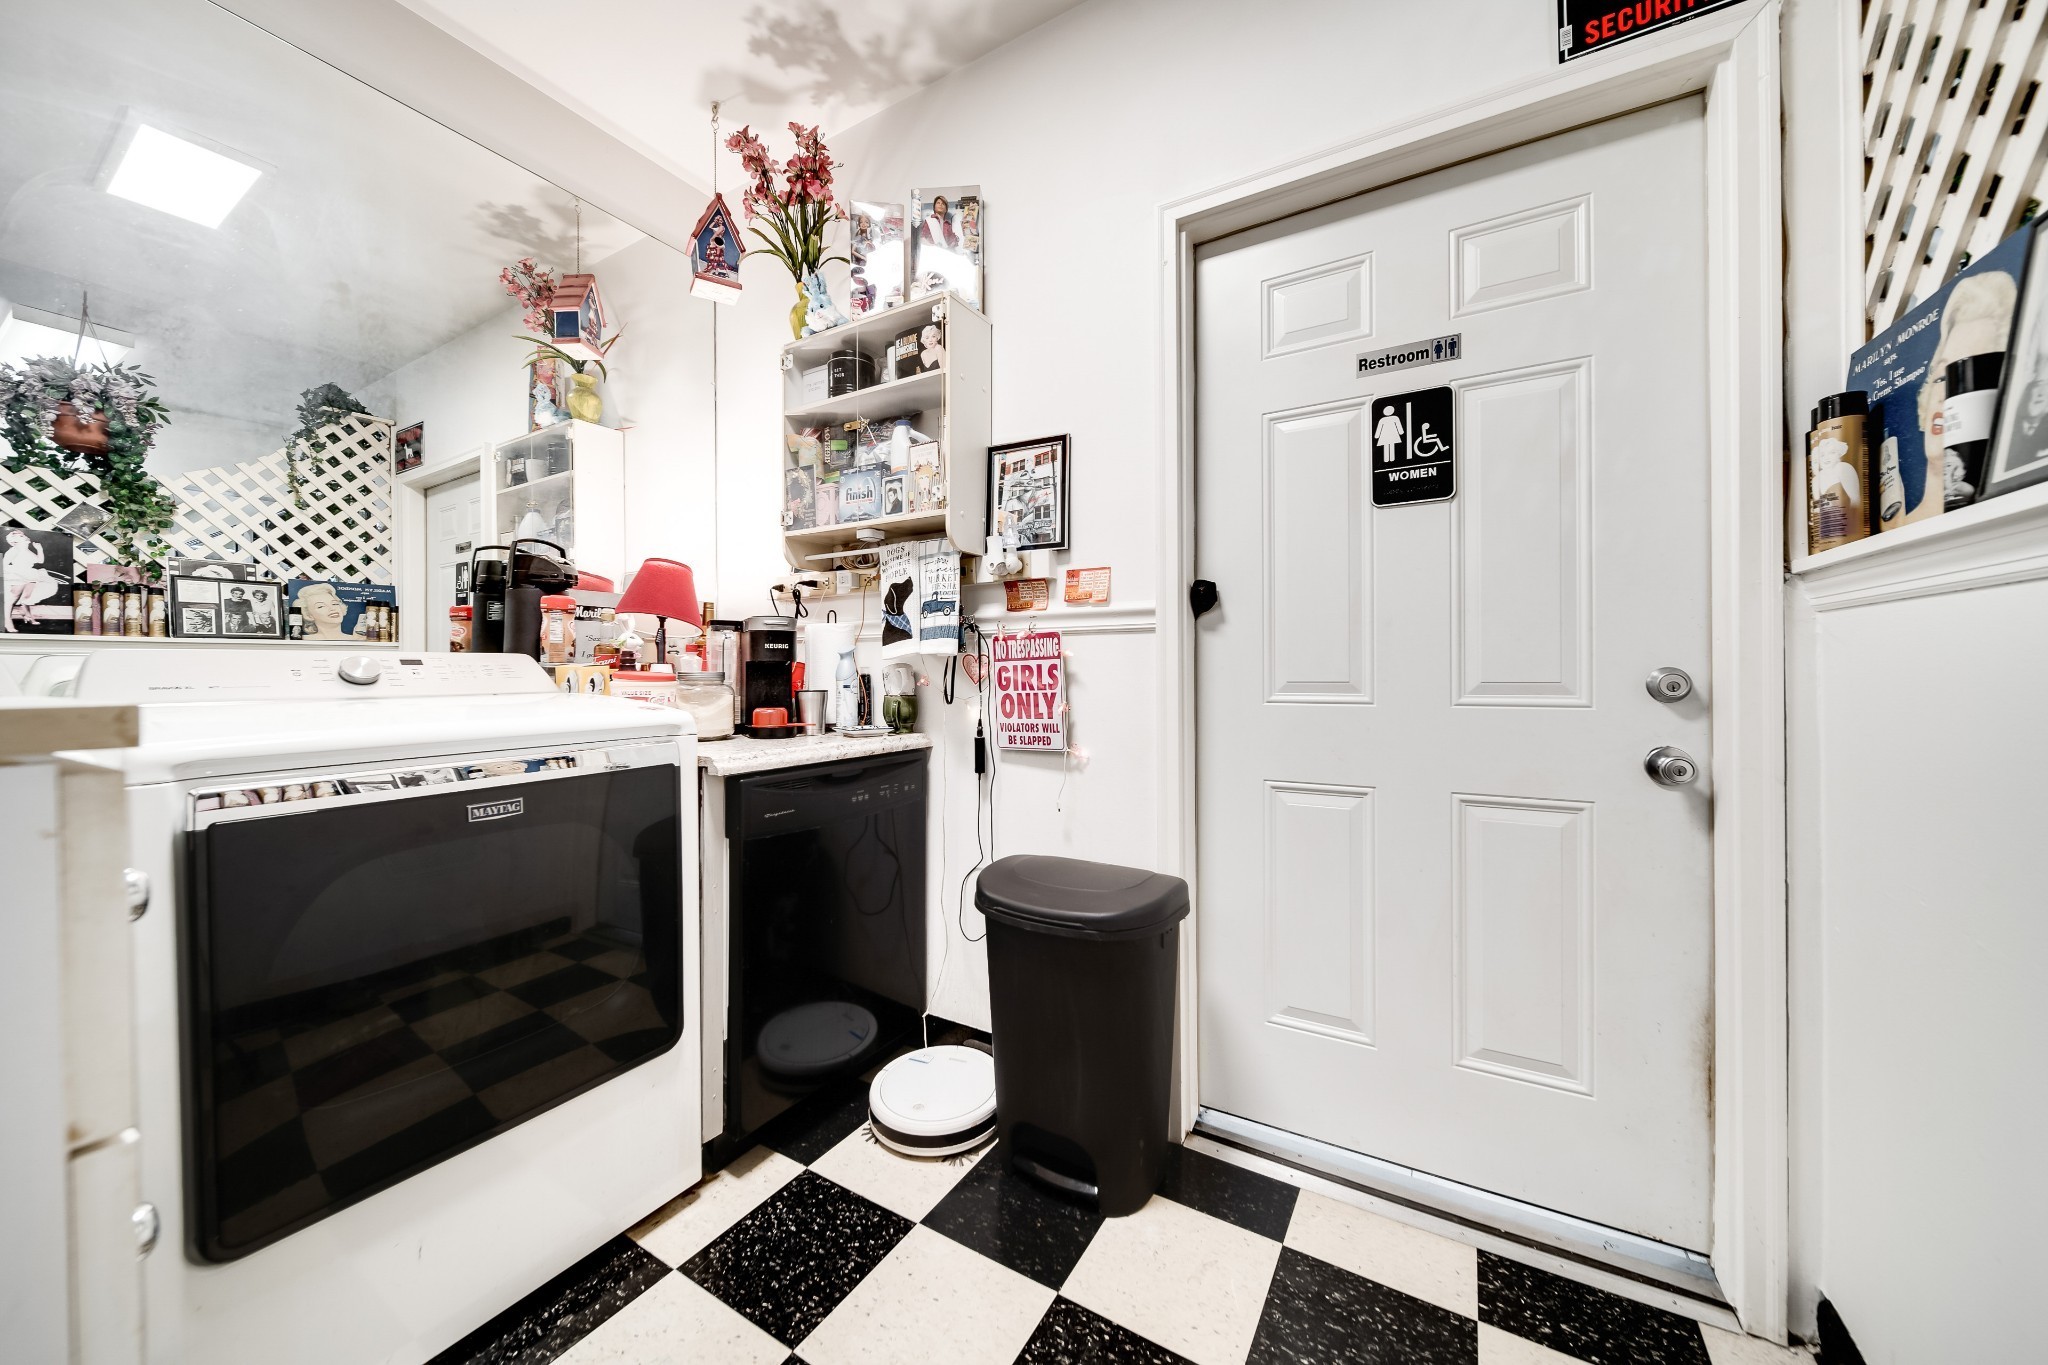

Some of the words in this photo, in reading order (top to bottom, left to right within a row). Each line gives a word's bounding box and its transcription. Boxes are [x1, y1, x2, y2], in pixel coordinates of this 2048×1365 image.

[1852, 341, 1892, 376] MARILYN
[1895, 308, 1940, 346] MONROE
[1358, 348, 1430, 372] Restroom
[1388, 467, 1437, 482] WOMEN
[845, 485, 873, 502] finish
[886, 545, 905, 557] DOGS
[576, 606, 602, 619] Maril
[995, 640, 1007, 660] NO
[1007, 638, 1060, 659] TRESPASSING
[997, 663, 1060, 692] GIRLS
[1001, 692, 1057, 719] ONLY
[1000, 722, 1040, 733] VIOLATORS
[1041, 722, 1061, 734] WILL
[1008, 734, 1018, 745] BE
[1019, 735, 1052, 746] SLAPPED
[472, 802, 521, 818] MAYTAG
